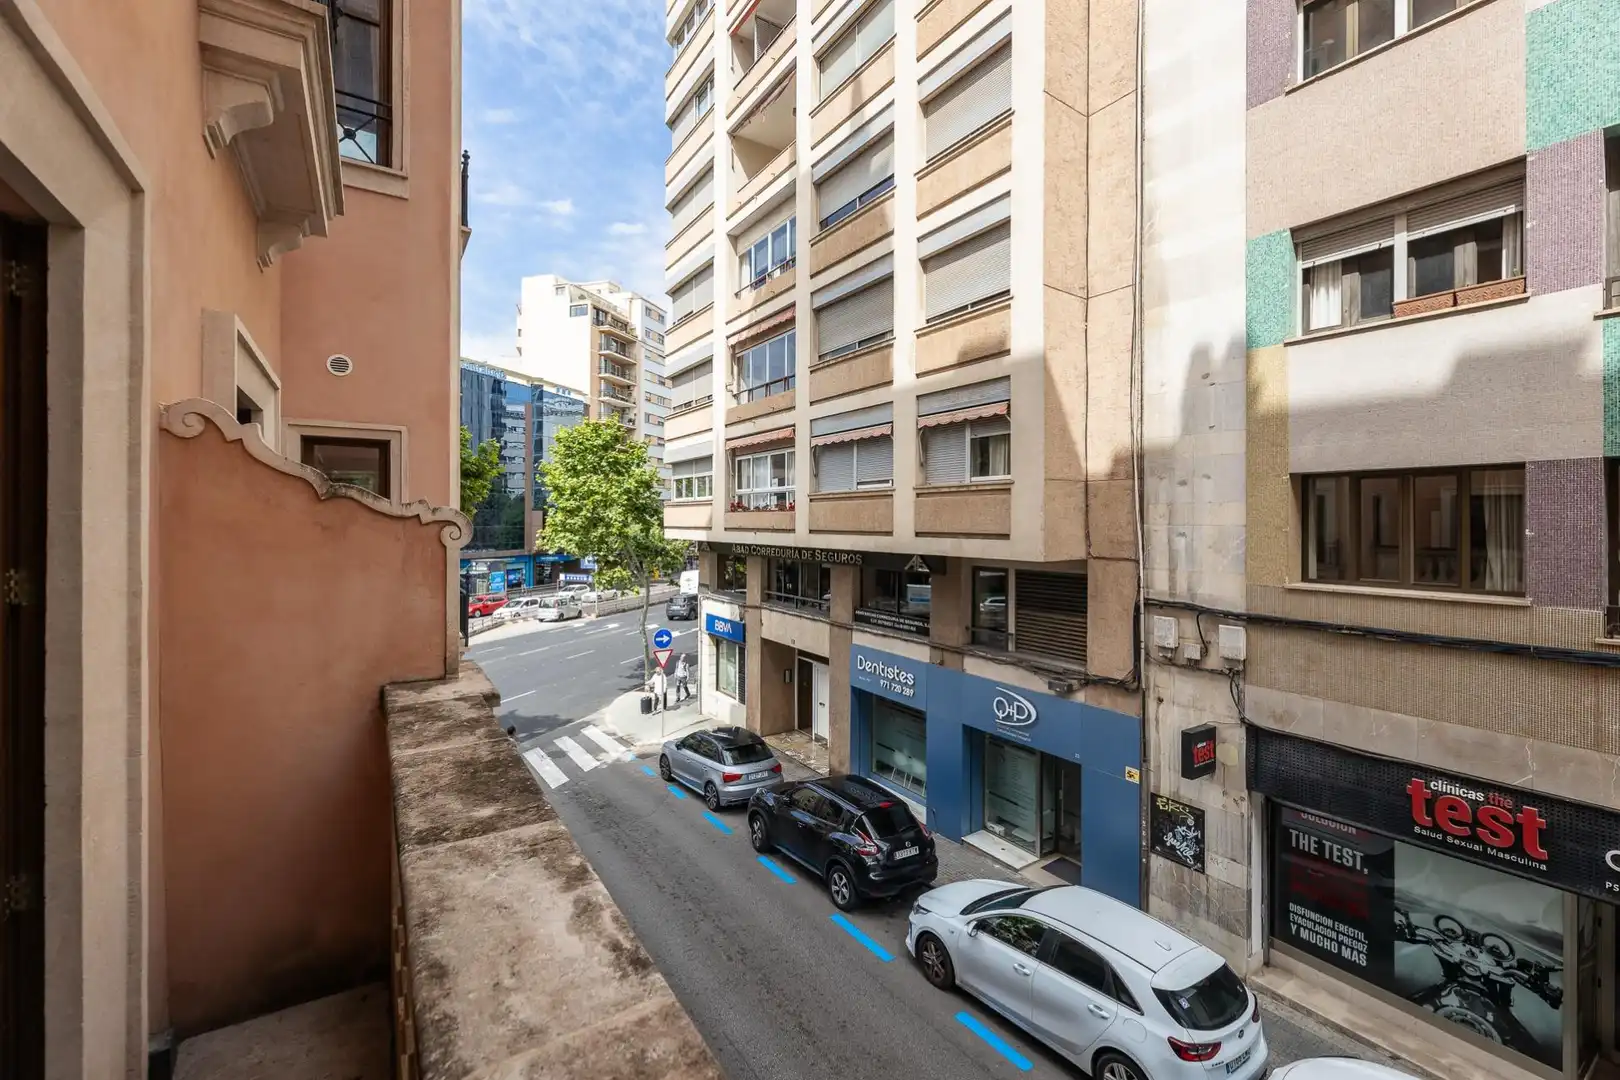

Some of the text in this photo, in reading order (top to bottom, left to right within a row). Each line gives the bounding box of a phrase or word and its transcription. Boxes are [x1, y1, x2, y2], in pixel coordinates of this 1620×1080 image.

[732, 544, 750, 554] ABAD
[801, 550, 814, 560] DE
[815, 550, 863, 565] SEGUROS
[714, 620, 732, 634] BBVA
[857, 654, 915, 686] Dentistes
[880, 679, 890, 689] 971
[891, 683, 902, 693] 720
[902, 686, 914, 697] 289
[1430, 780, 1513, 809] clínicas the
[1406, 777, 1548, 860] test
[1289, 829, 1318, 856] THE
[1414, 826, 1548, 871] Salud Sexual Masculina
[1289, 902, 1334, 928] DISFUNCION
[1290, 912, 1368, 954] EYACULACION PRECOZ
[1290, 922, 1367, 967] Y MUCHO MAS
